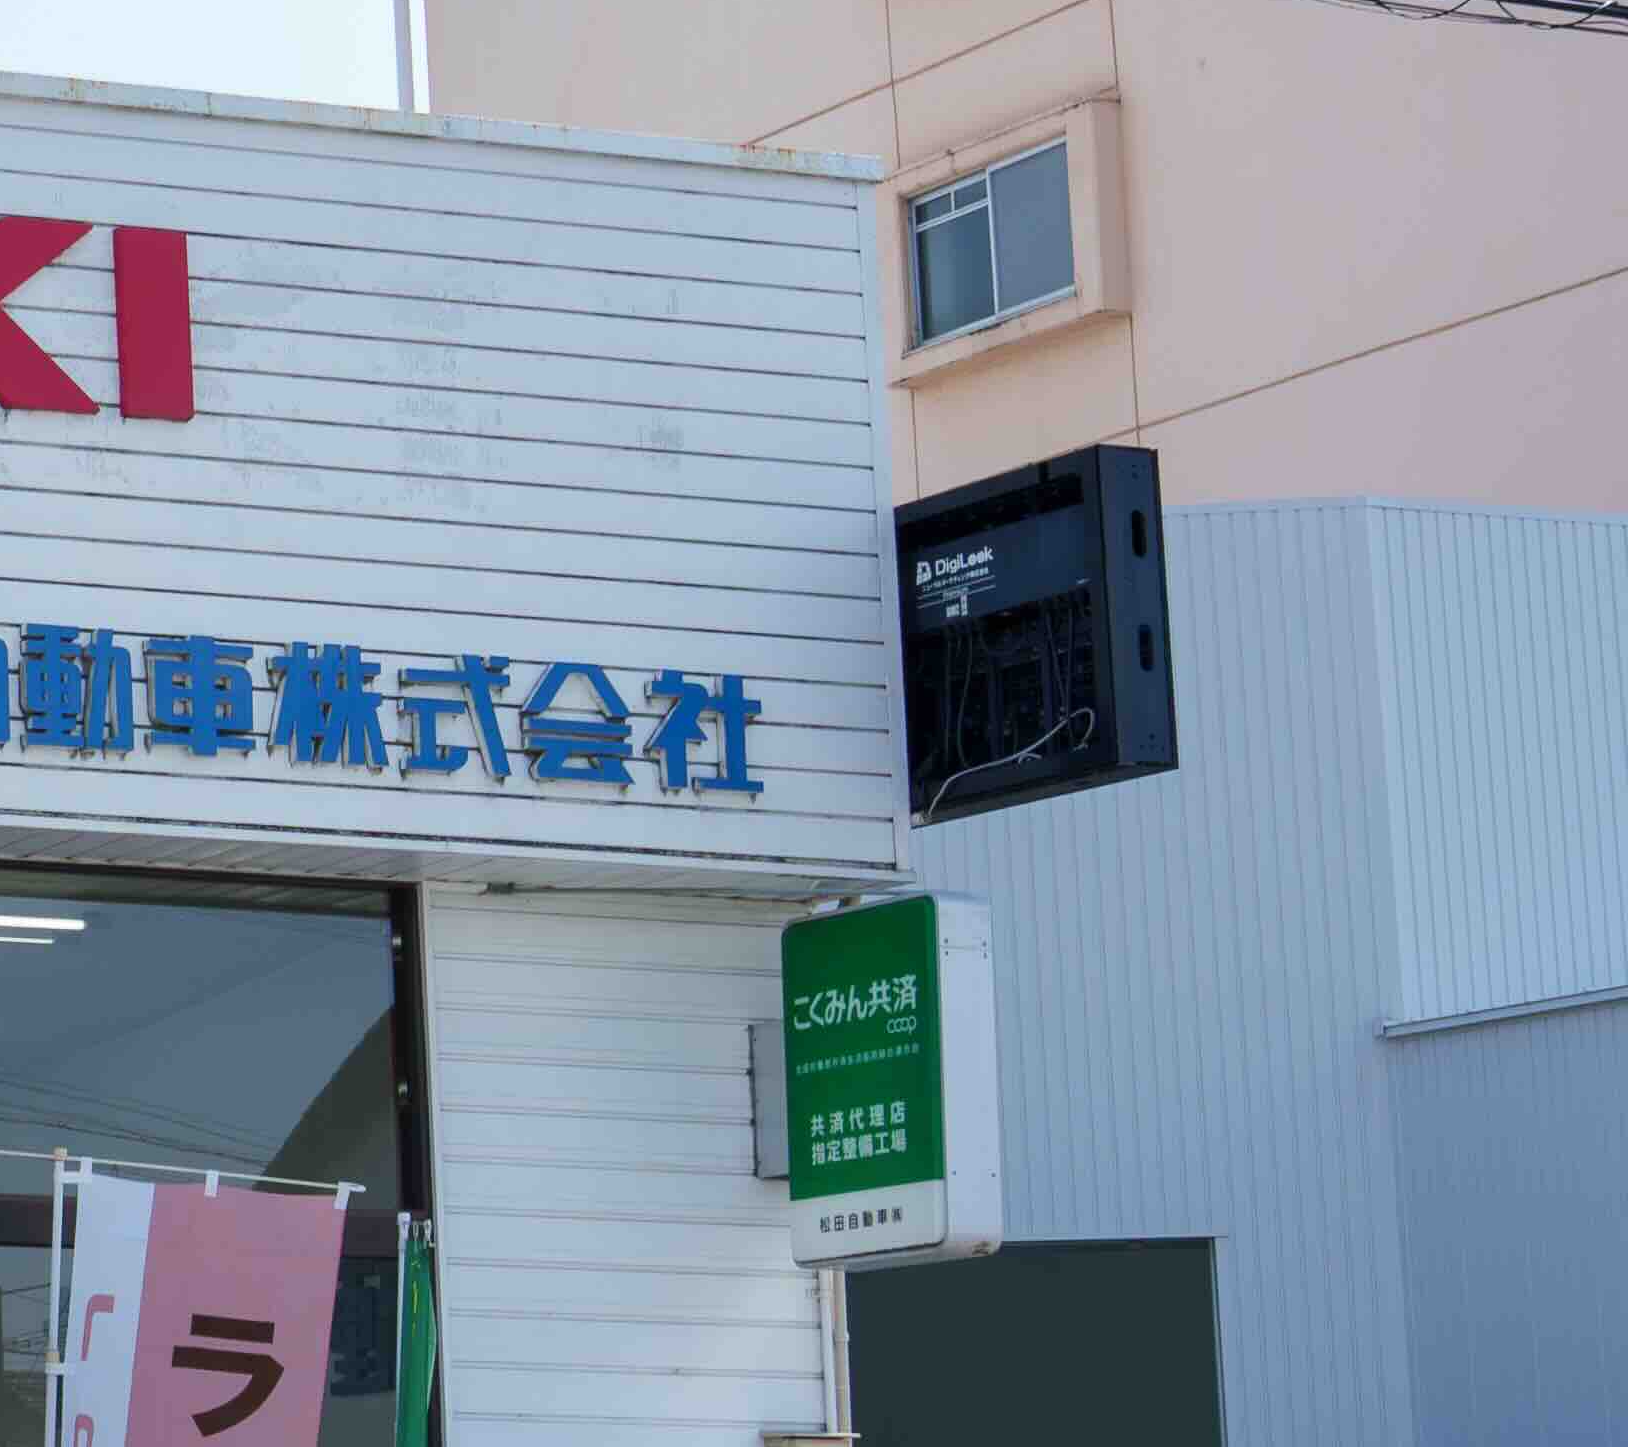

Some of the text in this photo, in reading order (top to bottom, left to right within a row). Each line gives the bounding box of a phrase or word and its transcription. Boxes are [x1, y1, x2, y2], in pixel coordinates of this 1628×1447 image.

[794, 974, 917, 1030] こくみん共済
[810, 1101, 907, 1138] 共済代理店
[811, 1128, 908, 1167] 指定整備工場
